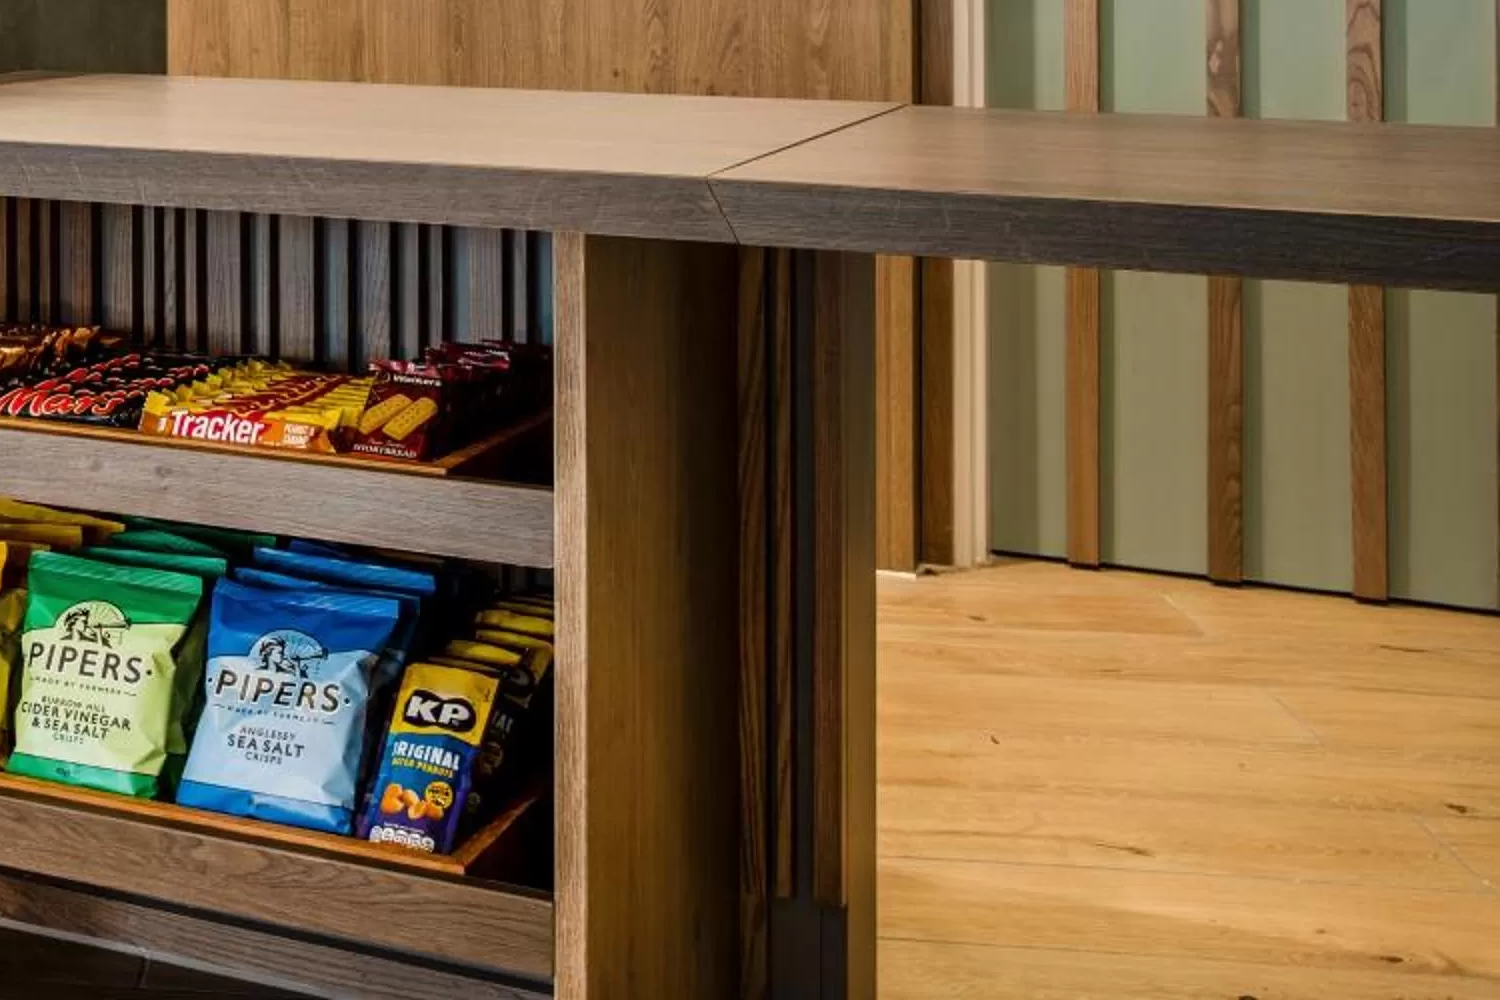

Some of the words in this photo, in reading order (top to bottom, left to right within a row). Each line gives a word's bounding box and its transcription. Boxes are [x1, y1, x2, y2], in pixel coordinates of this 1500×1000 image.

[171, 409, 265, 445] Tracker
[27, 641, 143, 684] PIPERS
[215, 669, 341, 713] PIPERS
[21, 701, 60, 717] CIDER
[64, 707, 131, 732] VINEGAR
[406, 694, 470, 725] KP
[31, 715, 42, 728] &
[43, 718, 70, 734] SEA
[73, 722, 110, 741] SALT
[227, 733, 257, 751] SEA
[262, 738, 305, 758] SALT
[244, 751, 283, 765] CRISPS
